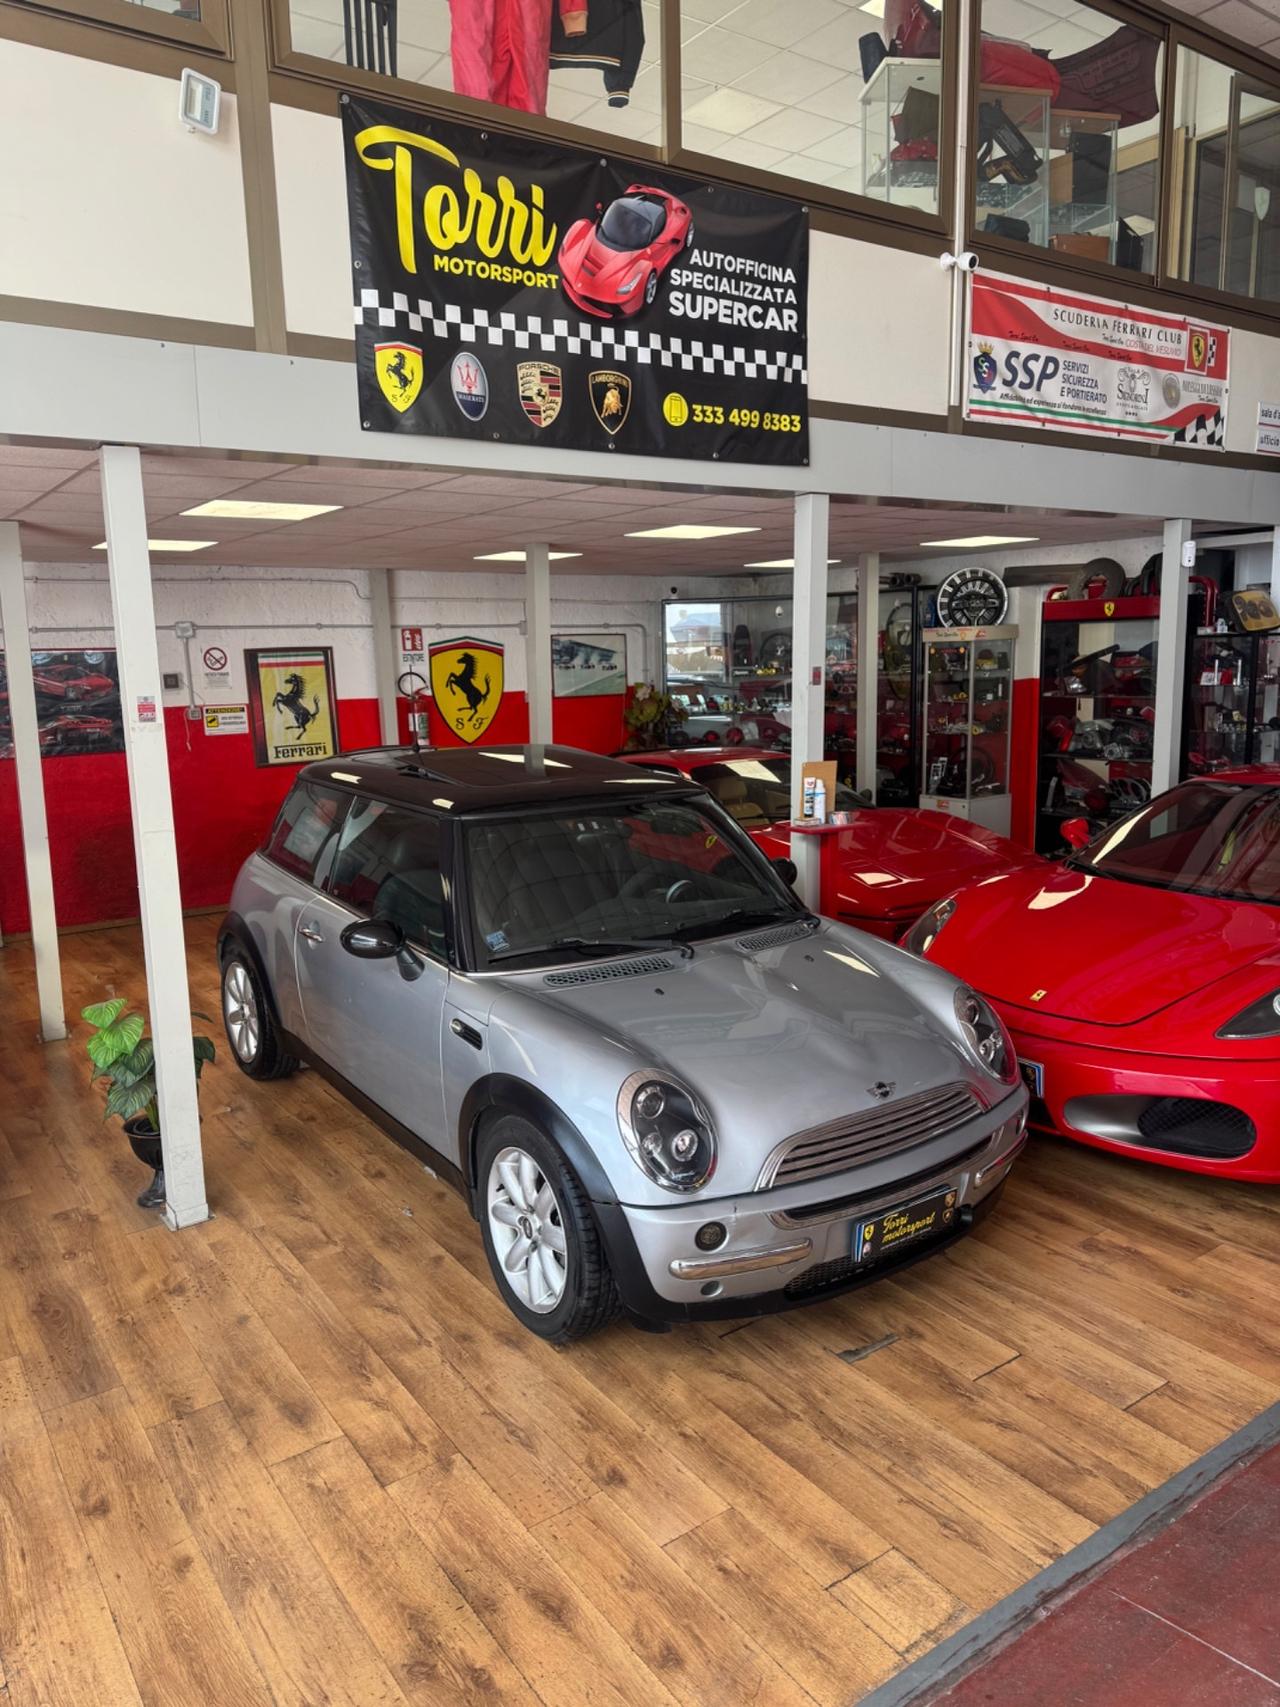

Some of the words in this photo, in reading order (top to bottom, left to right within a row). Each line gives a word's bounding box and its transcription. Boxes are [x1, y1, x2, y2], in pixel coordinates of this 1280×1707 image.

[354, 125, 558, 274] Torri
[433, 254, 559, 289] MOTORSPORT
[689, 248, 797, 284] AUTOFFICINA
[669, 268, 798, 305] SPECIALIZZATA
[668, 290, 798, 333] SUPERCAR
[1053, 308, 1109, 330] SCUDERIA
[1112, 319, 1152, 340] FERRARI
[1157, 329, 1182, 345] CLUB
[1002, 350, 1060, 392] SSP
[1062, 360, 1089, 374] SERVIZI
[1062, 373, 1099, 390] SICUREZZA
[1060, 387, 1065, 398] E
[1066, 387, 1108, 405] PORTIERATO
[692, 404, 725, 423] 333
[728, 408, 760, 428] 499
[762, 412, 802, 433] 8383
[455, 717, 465, 730] S
[273, 742, 328, 759] Ferrari
